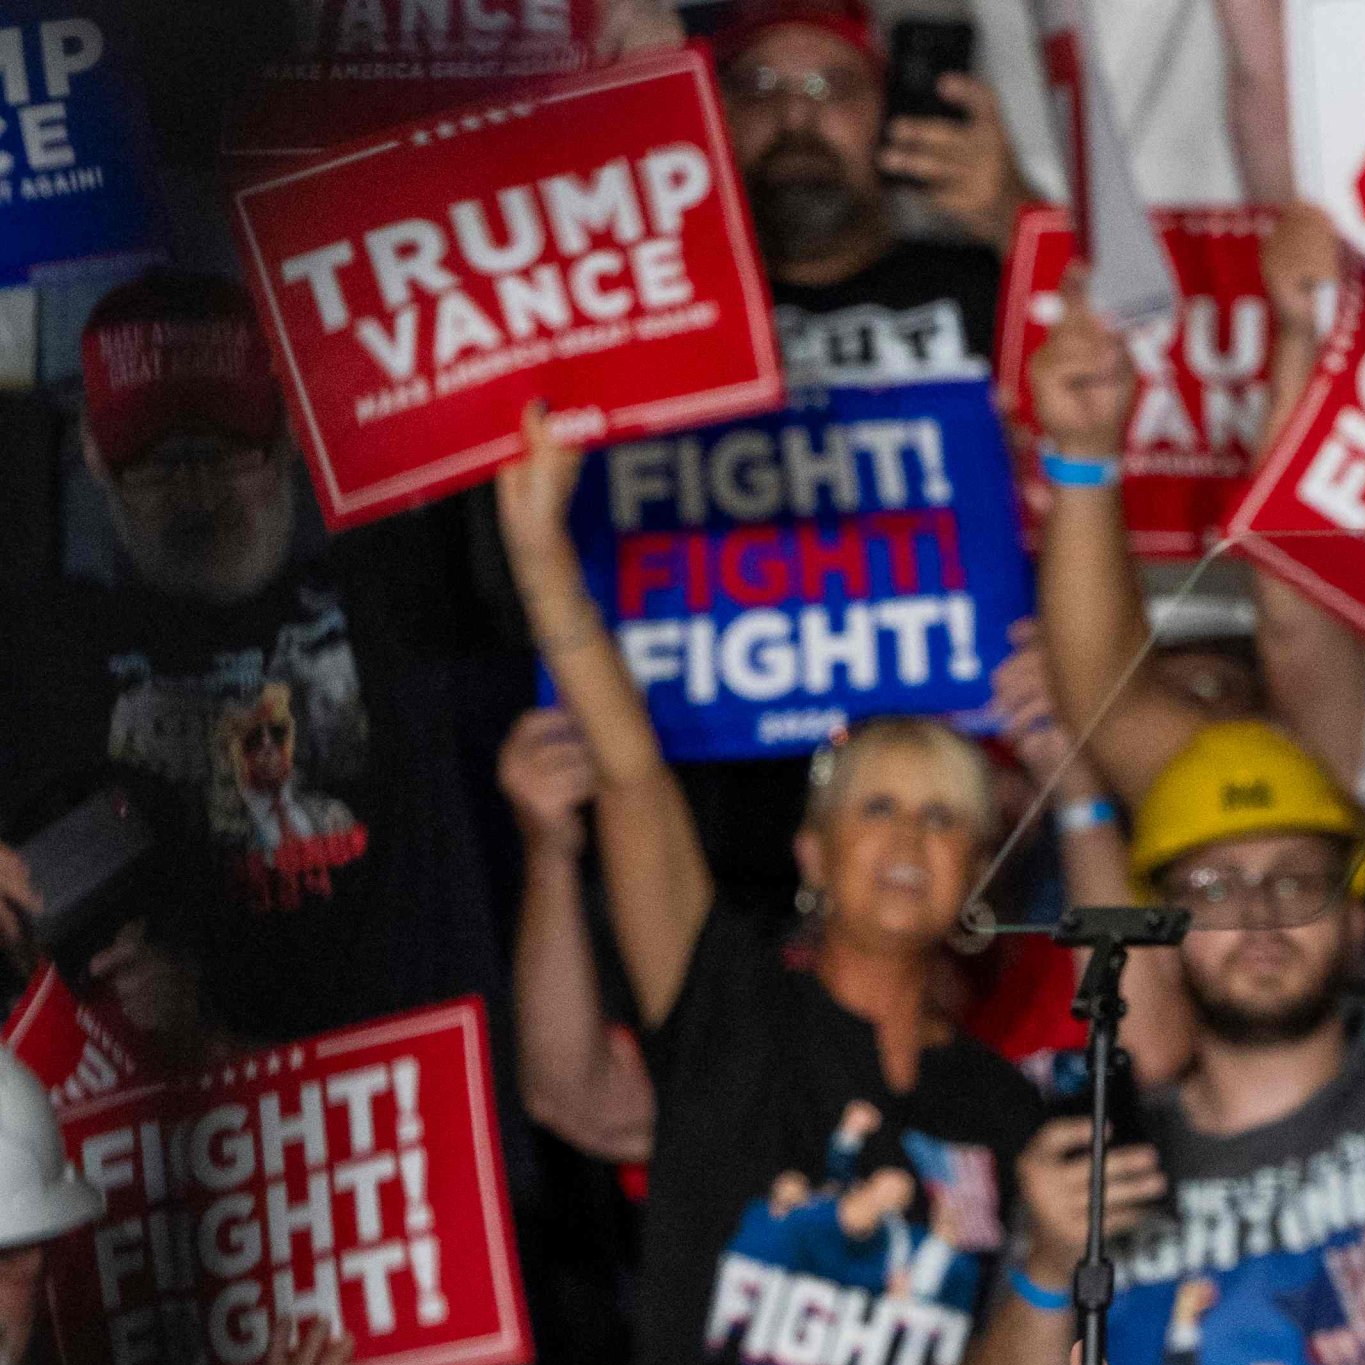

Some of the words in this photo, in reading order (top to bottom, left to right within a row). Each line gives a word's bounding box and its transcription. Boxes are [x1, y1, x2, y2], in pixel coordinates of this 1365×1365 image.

[280, 142, 713, 333] TRUMP
[354, 238, 696, 381] VANCE
[607, 417, 953, 532] FIGHT!
[615, 507, 968, 620] FIGHT!
[618, 590, 984, 705] FIGHT!
[81, 1055, 426, 1206] FIGHT!
[93, 1144, 436, 1310] FIGHT!
